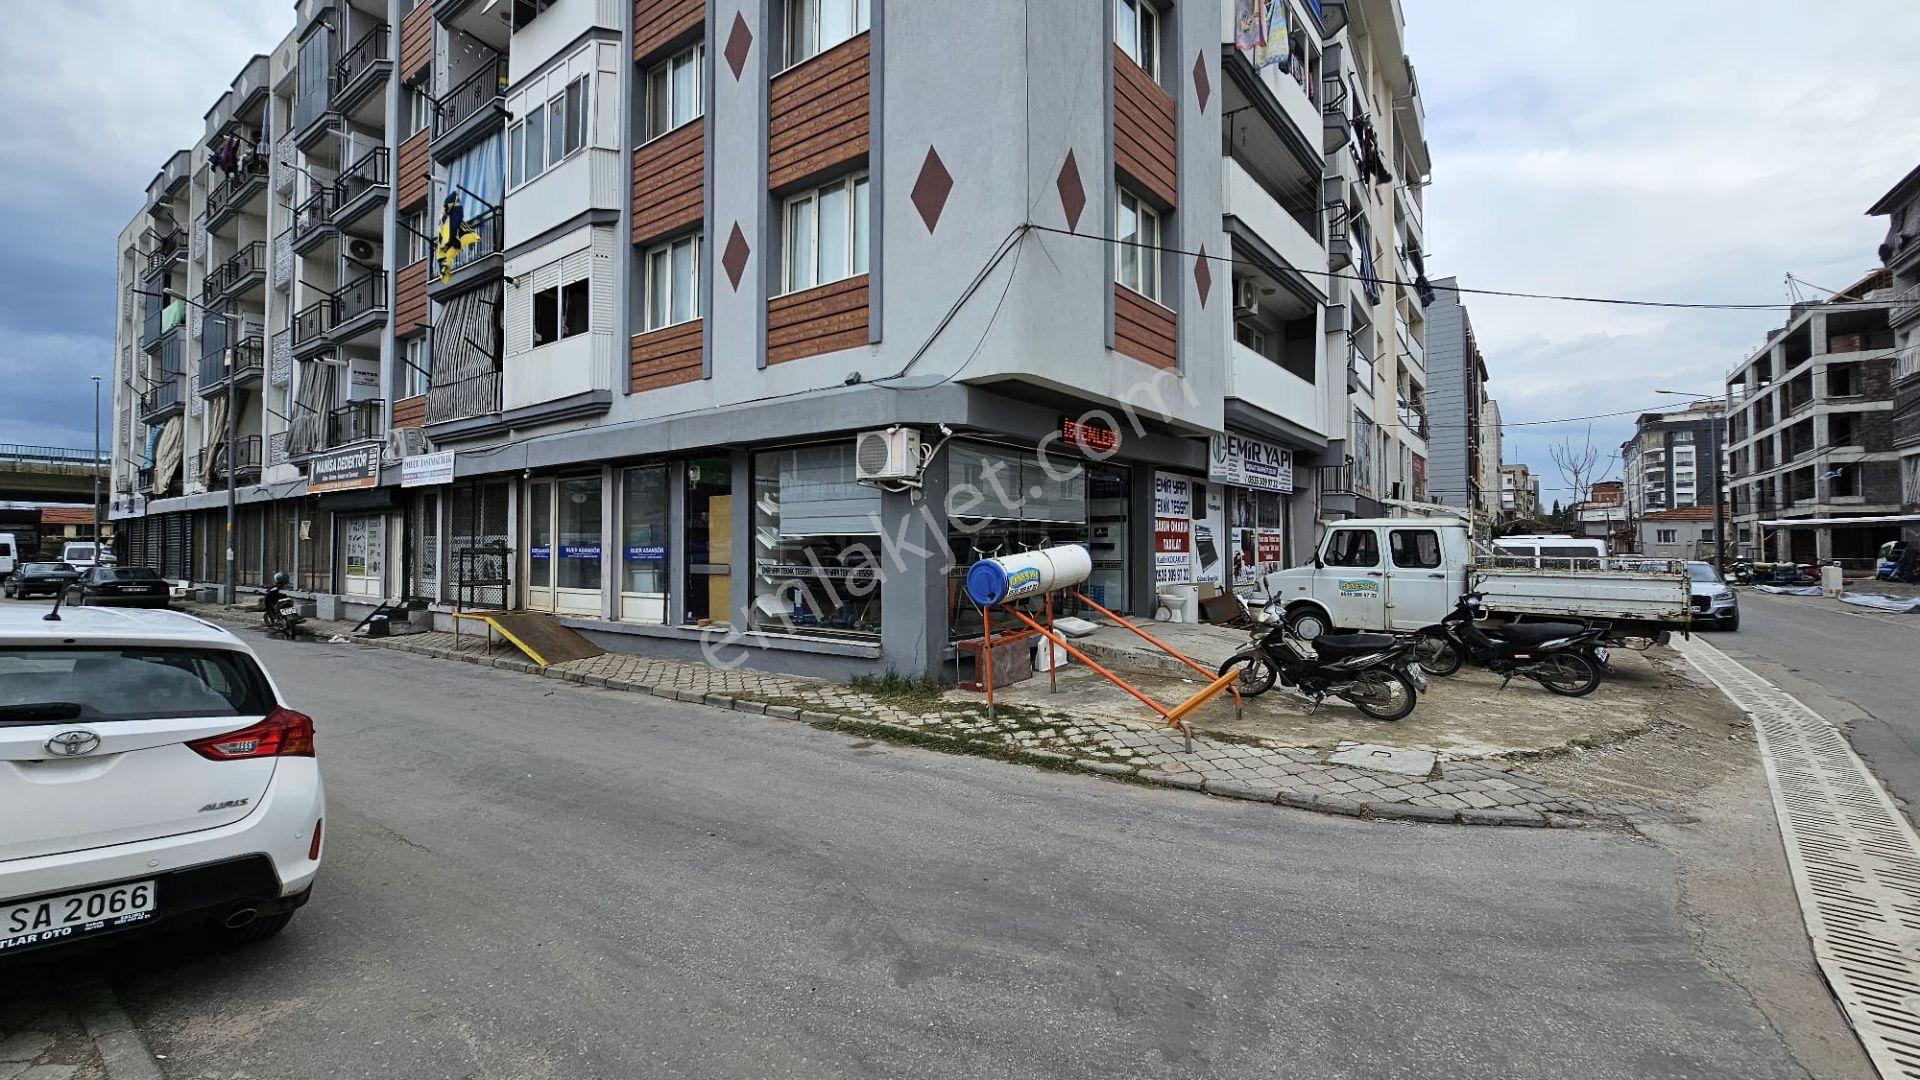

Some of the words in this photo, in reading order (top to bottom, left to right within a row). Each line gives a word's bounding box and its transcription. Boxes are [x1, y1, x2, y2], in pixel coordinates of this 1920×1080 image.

[1228, 436, 1261, 462] EMİR
[1264, 445, 1291, 469] YAPI
[198, 798, 249, 813] AURIS
[8, 903, 51, 933] SA
[63, 885, 149, 923] 2066
[41, 926, 72, 940] OTO
